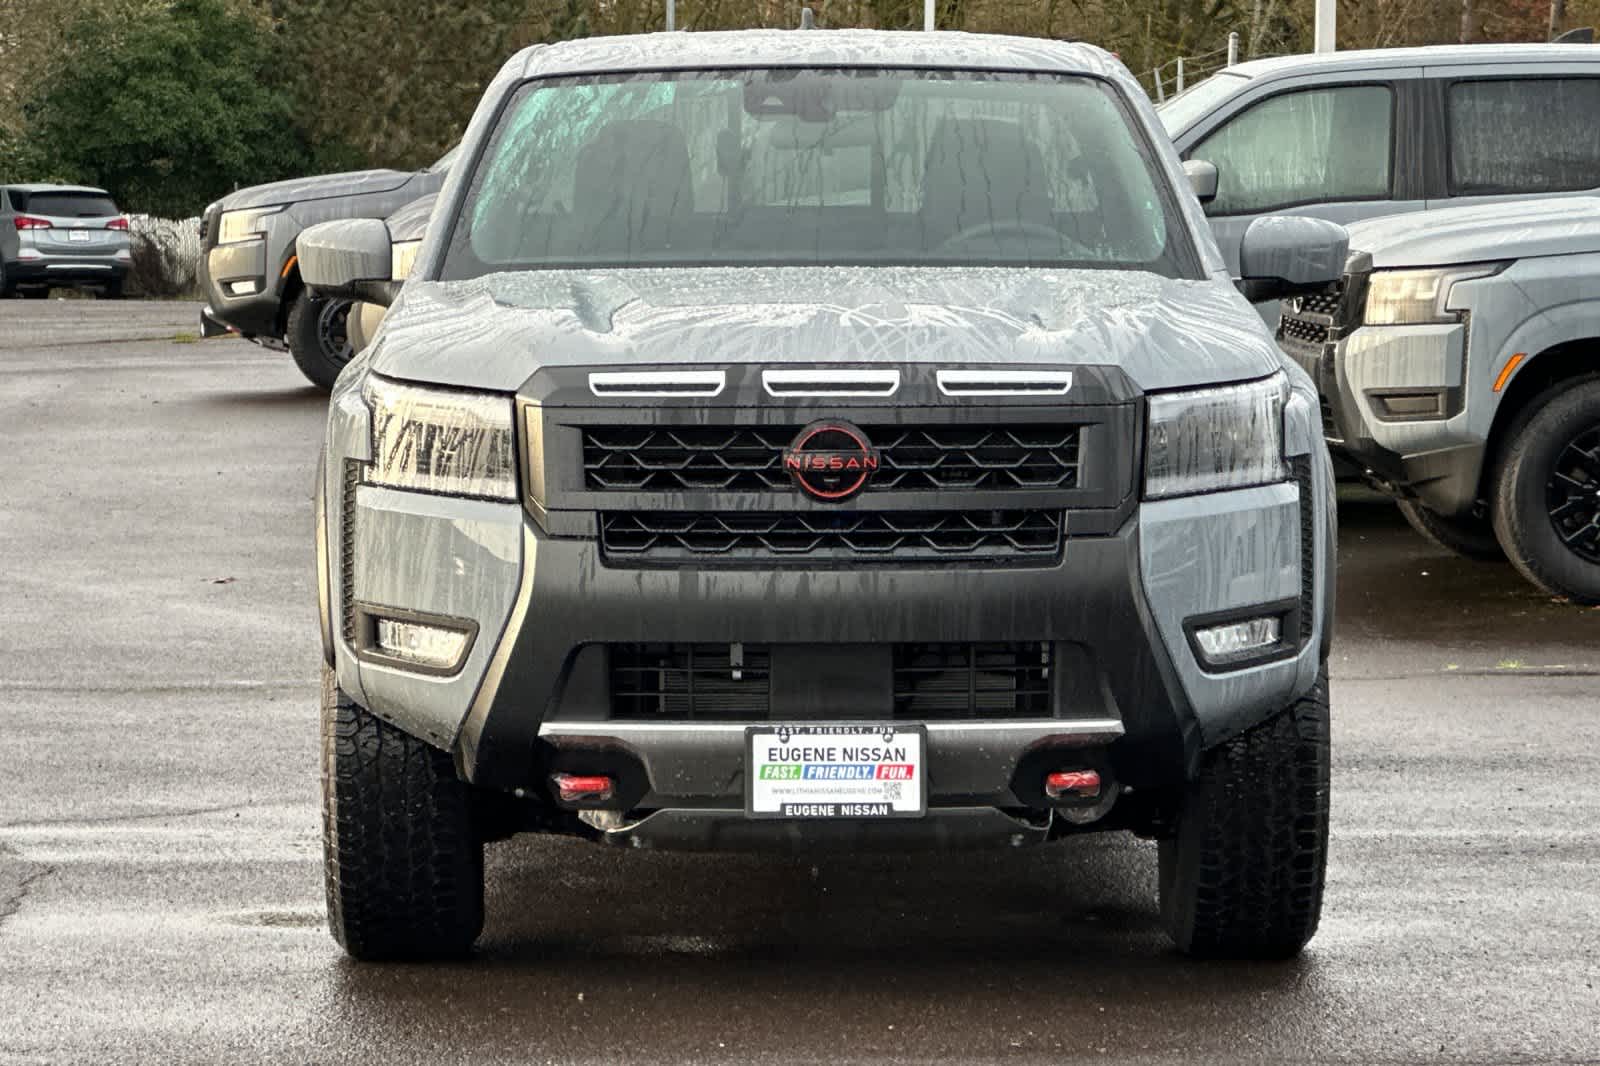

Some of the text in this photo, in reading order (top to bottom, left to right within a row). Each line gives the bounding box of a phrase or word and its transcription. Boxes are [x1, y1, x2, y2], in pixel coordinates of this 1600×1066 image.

[786, 456, 877, 469] NISSAN
[768, 747, 906, 762] EUGENE NISSAN
[765, 766, 911, 779] FAST. FRIENDLY. FUN.
[785, 805, 888, 816] EUGENE NISSAN
